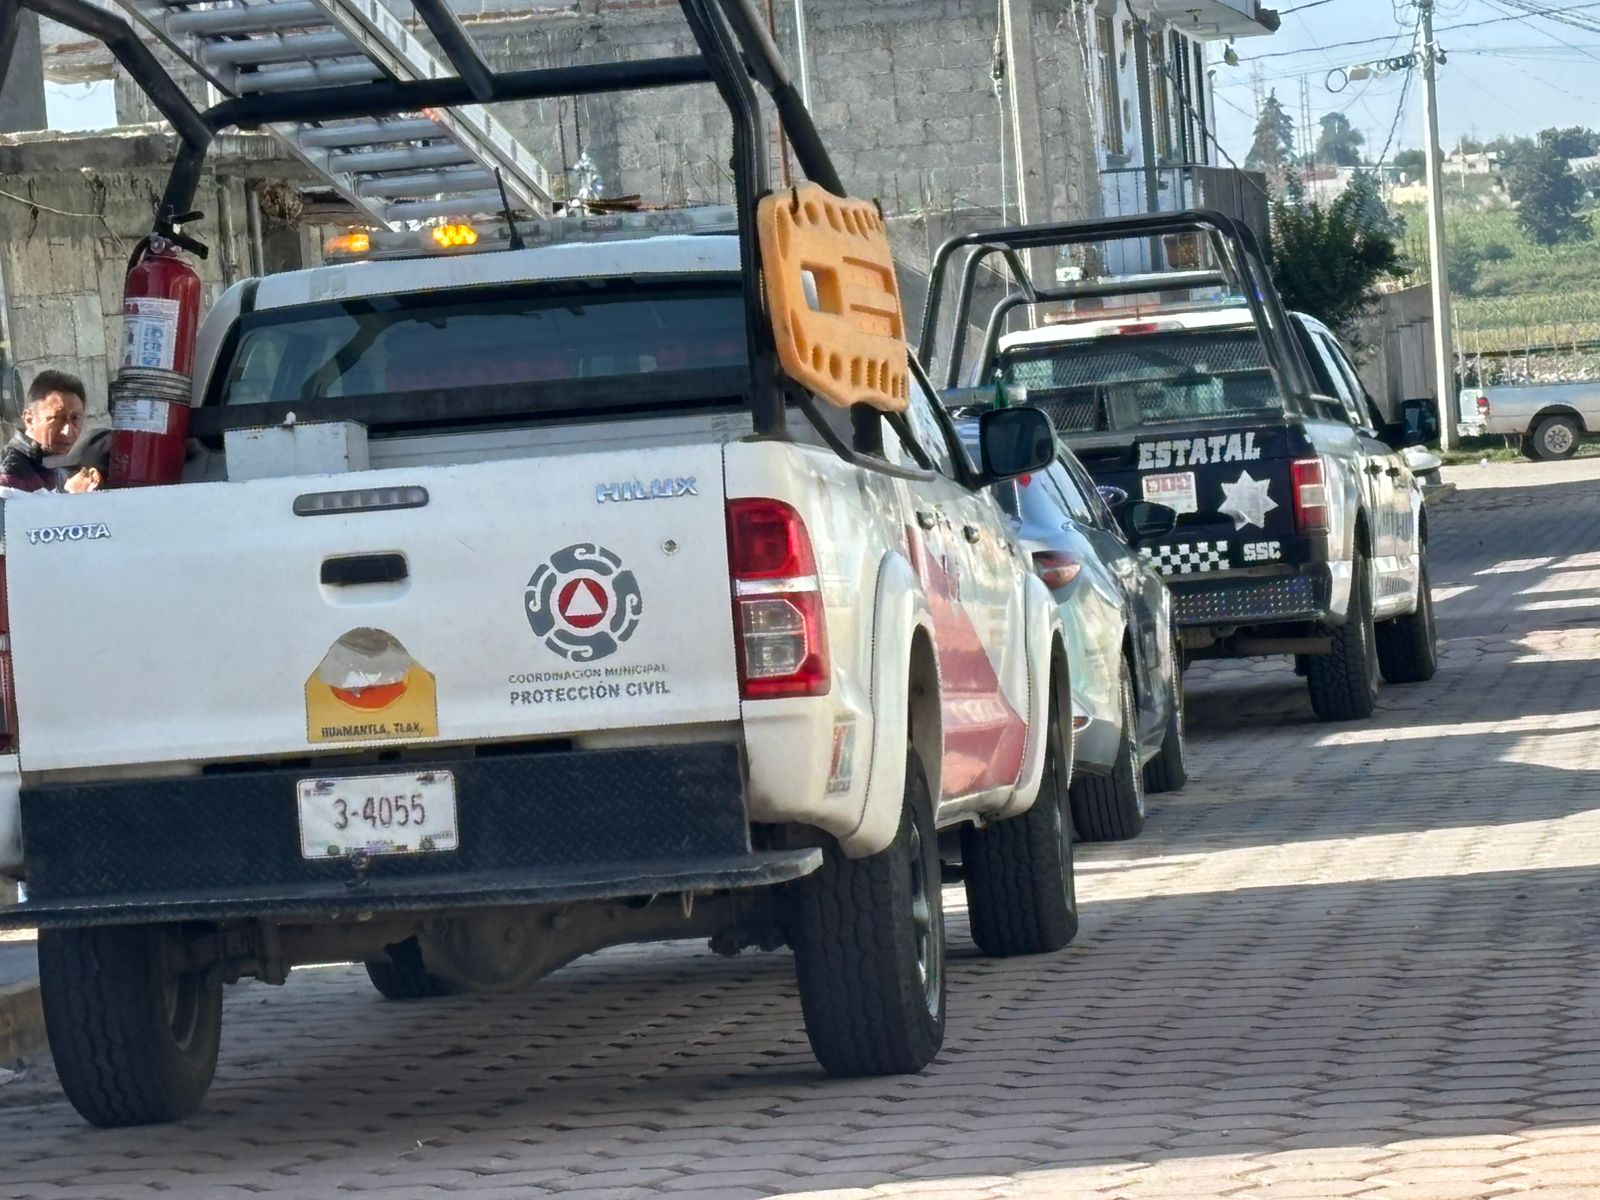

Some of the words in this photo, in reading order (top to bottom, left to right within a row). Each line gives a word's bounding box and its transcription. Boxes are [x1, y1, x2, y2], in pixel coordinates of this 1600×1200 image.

[1138, 432, 1261, 470] ESTATAL
[595, 475, 699, 503] HILUX
[27, 522, 111, 545] TOYOTA
[1243, 541, 1281, 562] SSC
[605, 663, 669, 677] MUNICIPAL
[510, 681, 620, 706] PROTECCIÓN
[626, 680, 671, 697] CIVIL
[333, 793, 426, 830] 3-4055
